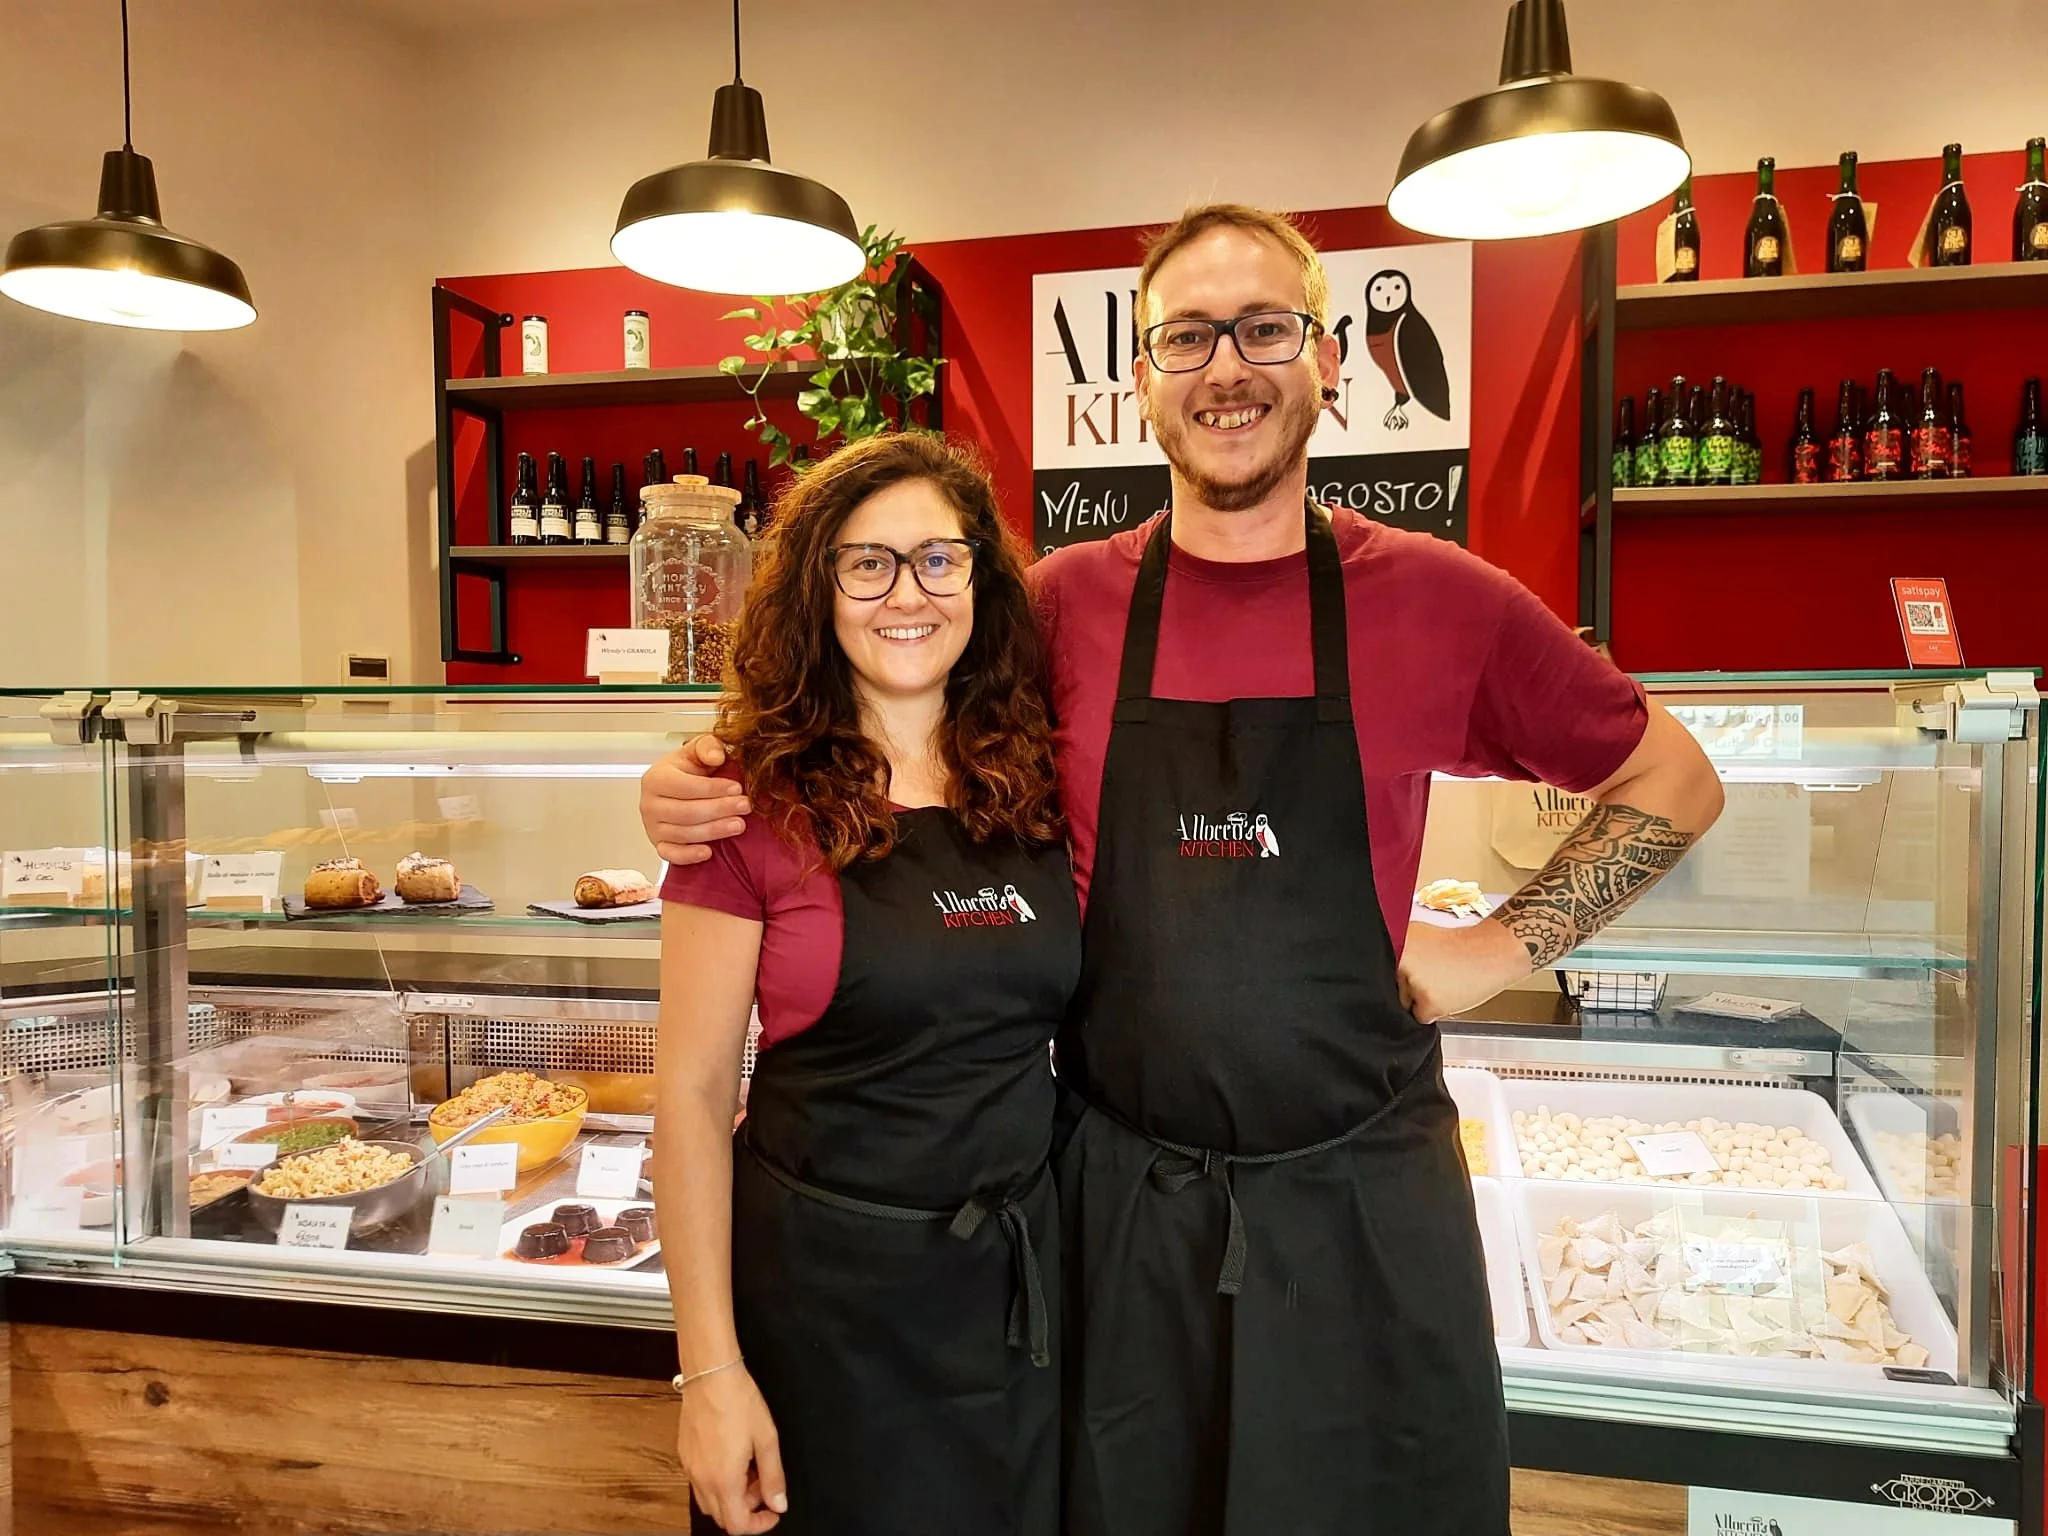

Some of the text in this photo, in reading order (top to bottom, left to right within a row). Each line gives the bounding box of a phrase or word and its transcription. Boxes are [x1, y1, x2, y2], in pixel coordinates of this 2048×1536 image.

[1041, 481, 1127, 533] MENU
[1902, 586, 1941, 599] satispay
[1179, 841, 1255, 857] KITCHEN
[943, 911, 1015, 928] KITCHEN
[1891, 1482, 1975, 1508] GROPPO
